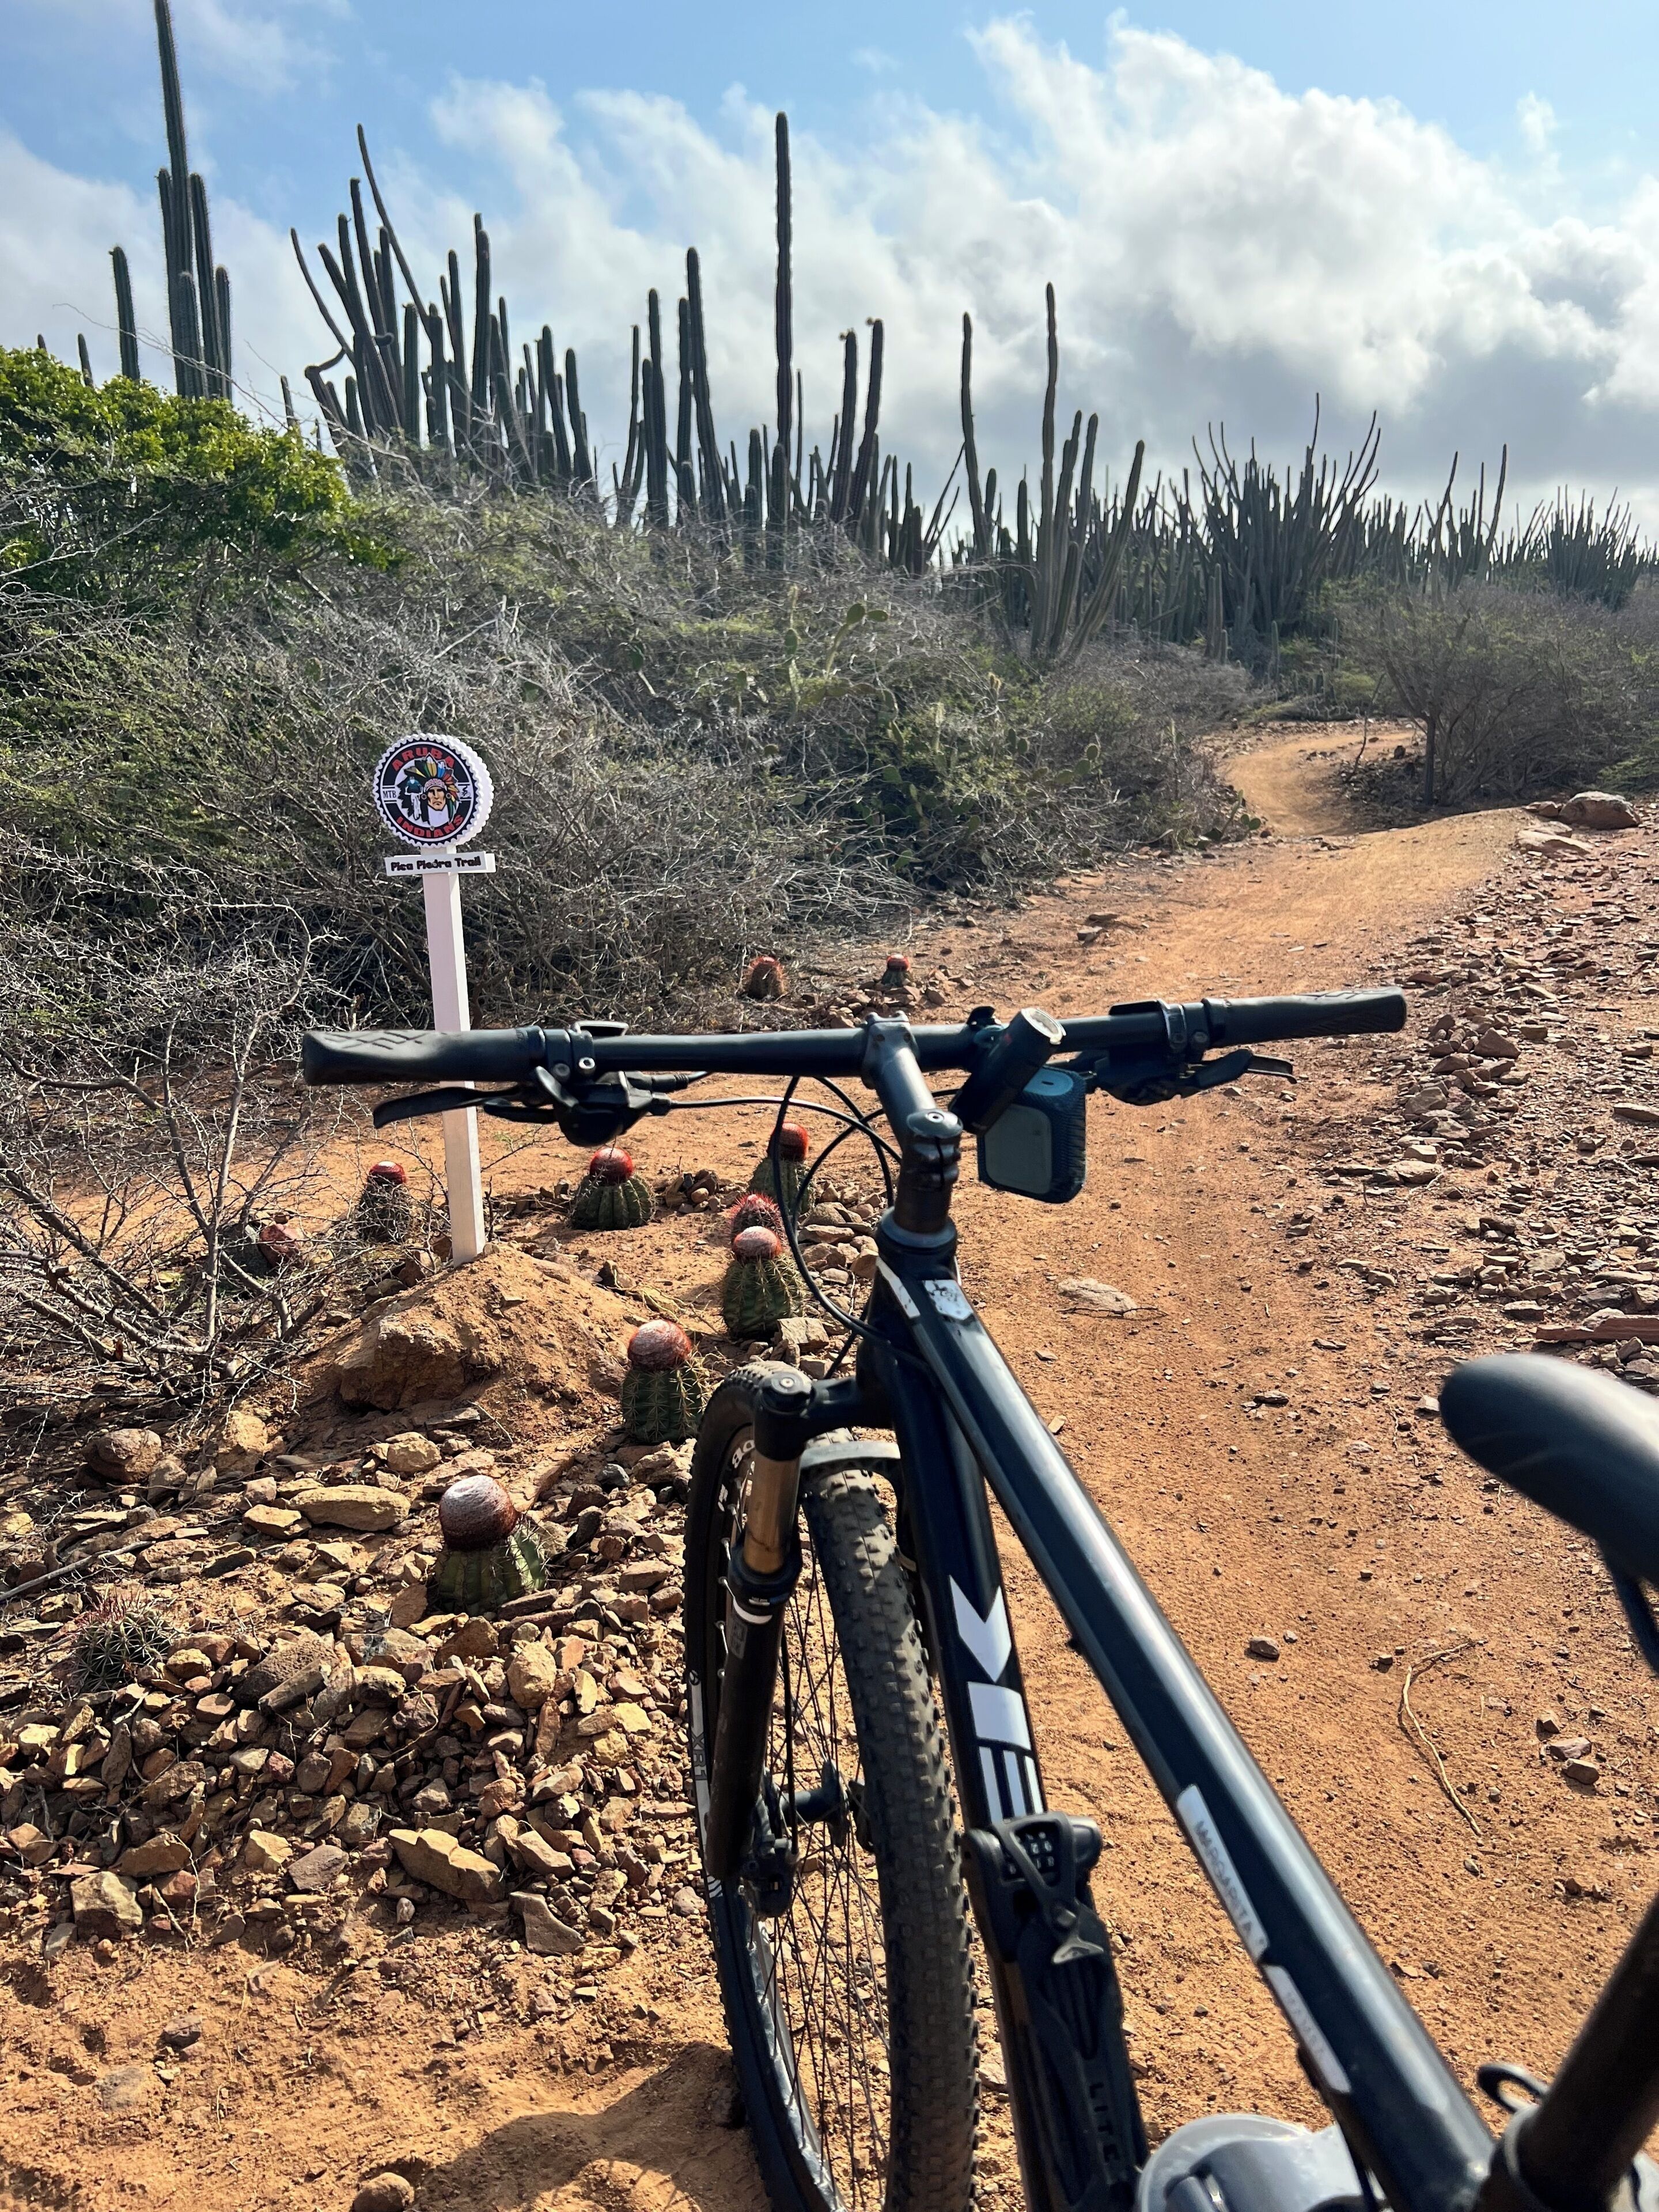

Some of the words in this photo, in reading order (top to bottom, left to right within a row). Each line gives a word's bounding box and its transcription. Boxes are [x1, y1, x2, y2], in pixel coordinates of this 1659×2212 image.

[392, 747, 455, 771] ARUBA
[383, 790, 397, 798] MTB
[396, 815, 464, 838] INDIANS
[391, 862, 414, 872] Pica
[416, 859, 452, 869] Piedra
[454, 855, 482, 867] Trail
